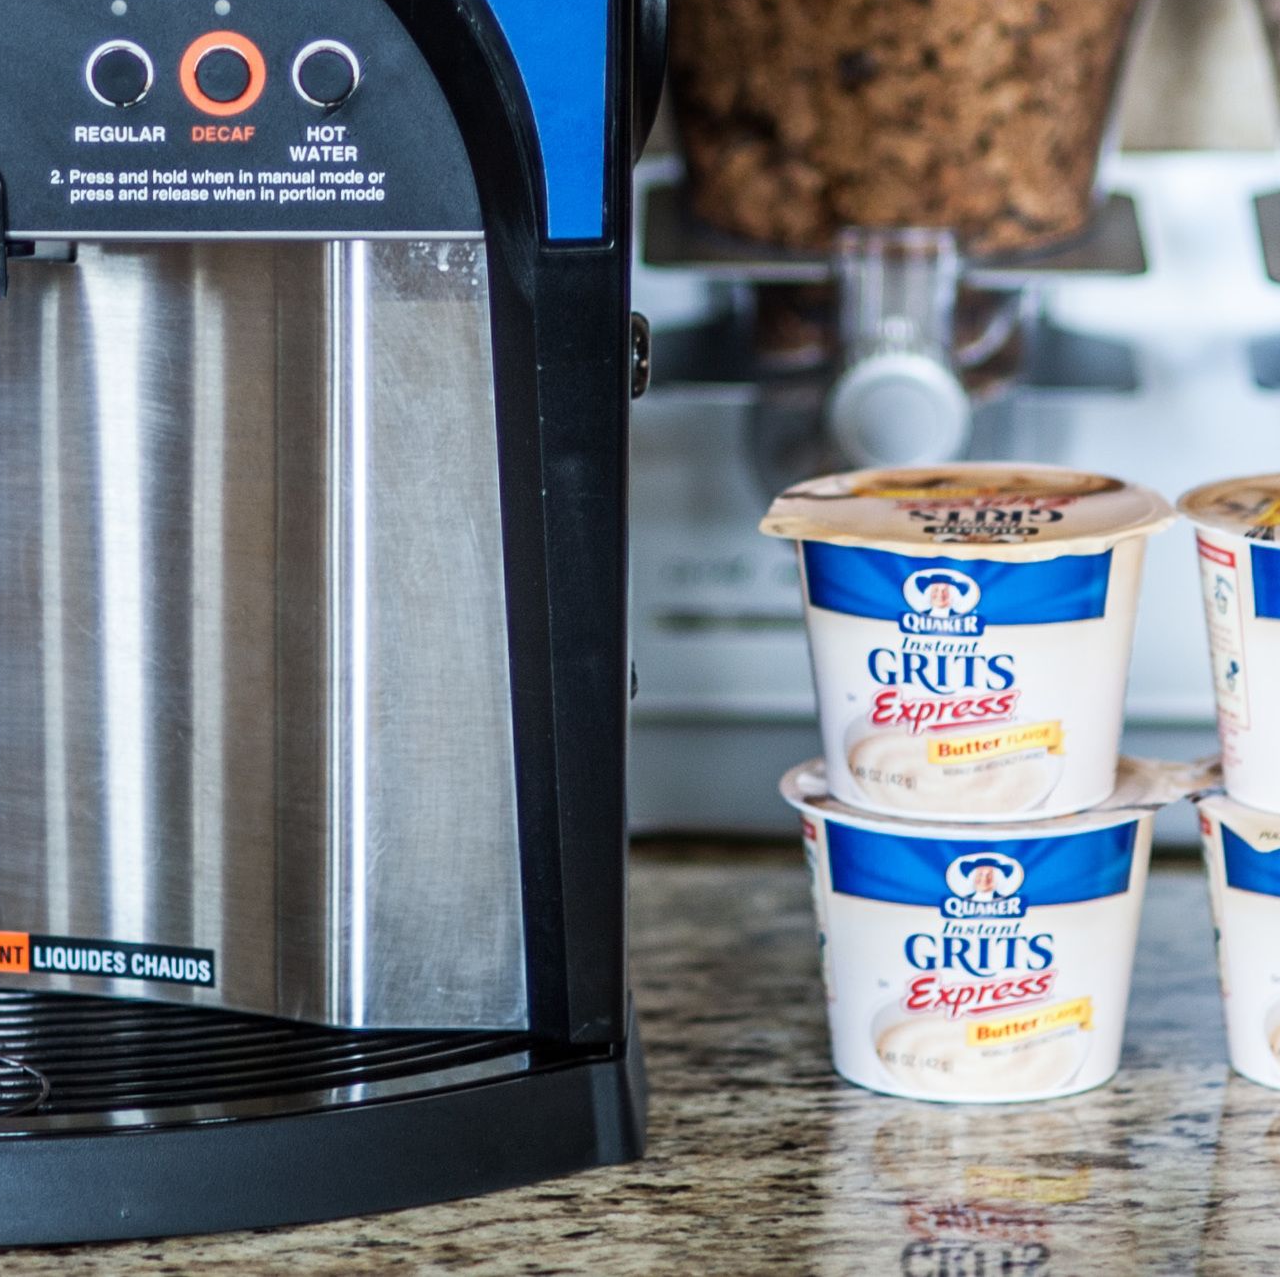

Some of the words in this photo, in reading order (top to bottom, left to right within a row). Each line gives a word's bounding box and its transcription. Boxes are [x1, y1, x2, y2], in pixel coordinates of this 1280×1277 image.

[74, 126, 166, 142] REGULAR
[191, 126, 256, 142] DECAF
[306, 126, 347, 142] HOT
[289, 146, 358, 162] WATER
[50, 170, 64, 184] 2.
[70, 170, 114, 184] Press
[119, 170, 148, 184] and
[153, 170, 187, 184] hold
[192, 170, 234, 184] when
[239, 170, 253, 184] in
[258, 170, 315, 184] manual
[320, 170, 364, 184] mode
[368, 173, 385, 184] or
[70, 190, 114, 204] press
[119, 187, 148, 201] and
[153, 187, 208, 201] release
[213, 187, 255, 201] when
[261, 187, 274, 201] in
[279, 187, 336, 204] portion
[341, 187, 385, 201] mode
[902, 612, 979, 634] QUAKER
[901, 636, 979, 654] Instant
[868, 648, 1014, 695] GRITS
[872, 691, 1016, 734] Express
[937, 736, 1001, 758] Butter
[944, 896, 1021, 917] QUAKER
[942, 920, 1021, 936] Instant
[34, 945, 127, 973] LIQUIDES
[131, 952, 212, 983] CHAUDS
[904, 933, 1053, 977] GRITS
[906, 972, 1052, 1016] Express
[976, 1018, 1038, 1042] Butter
